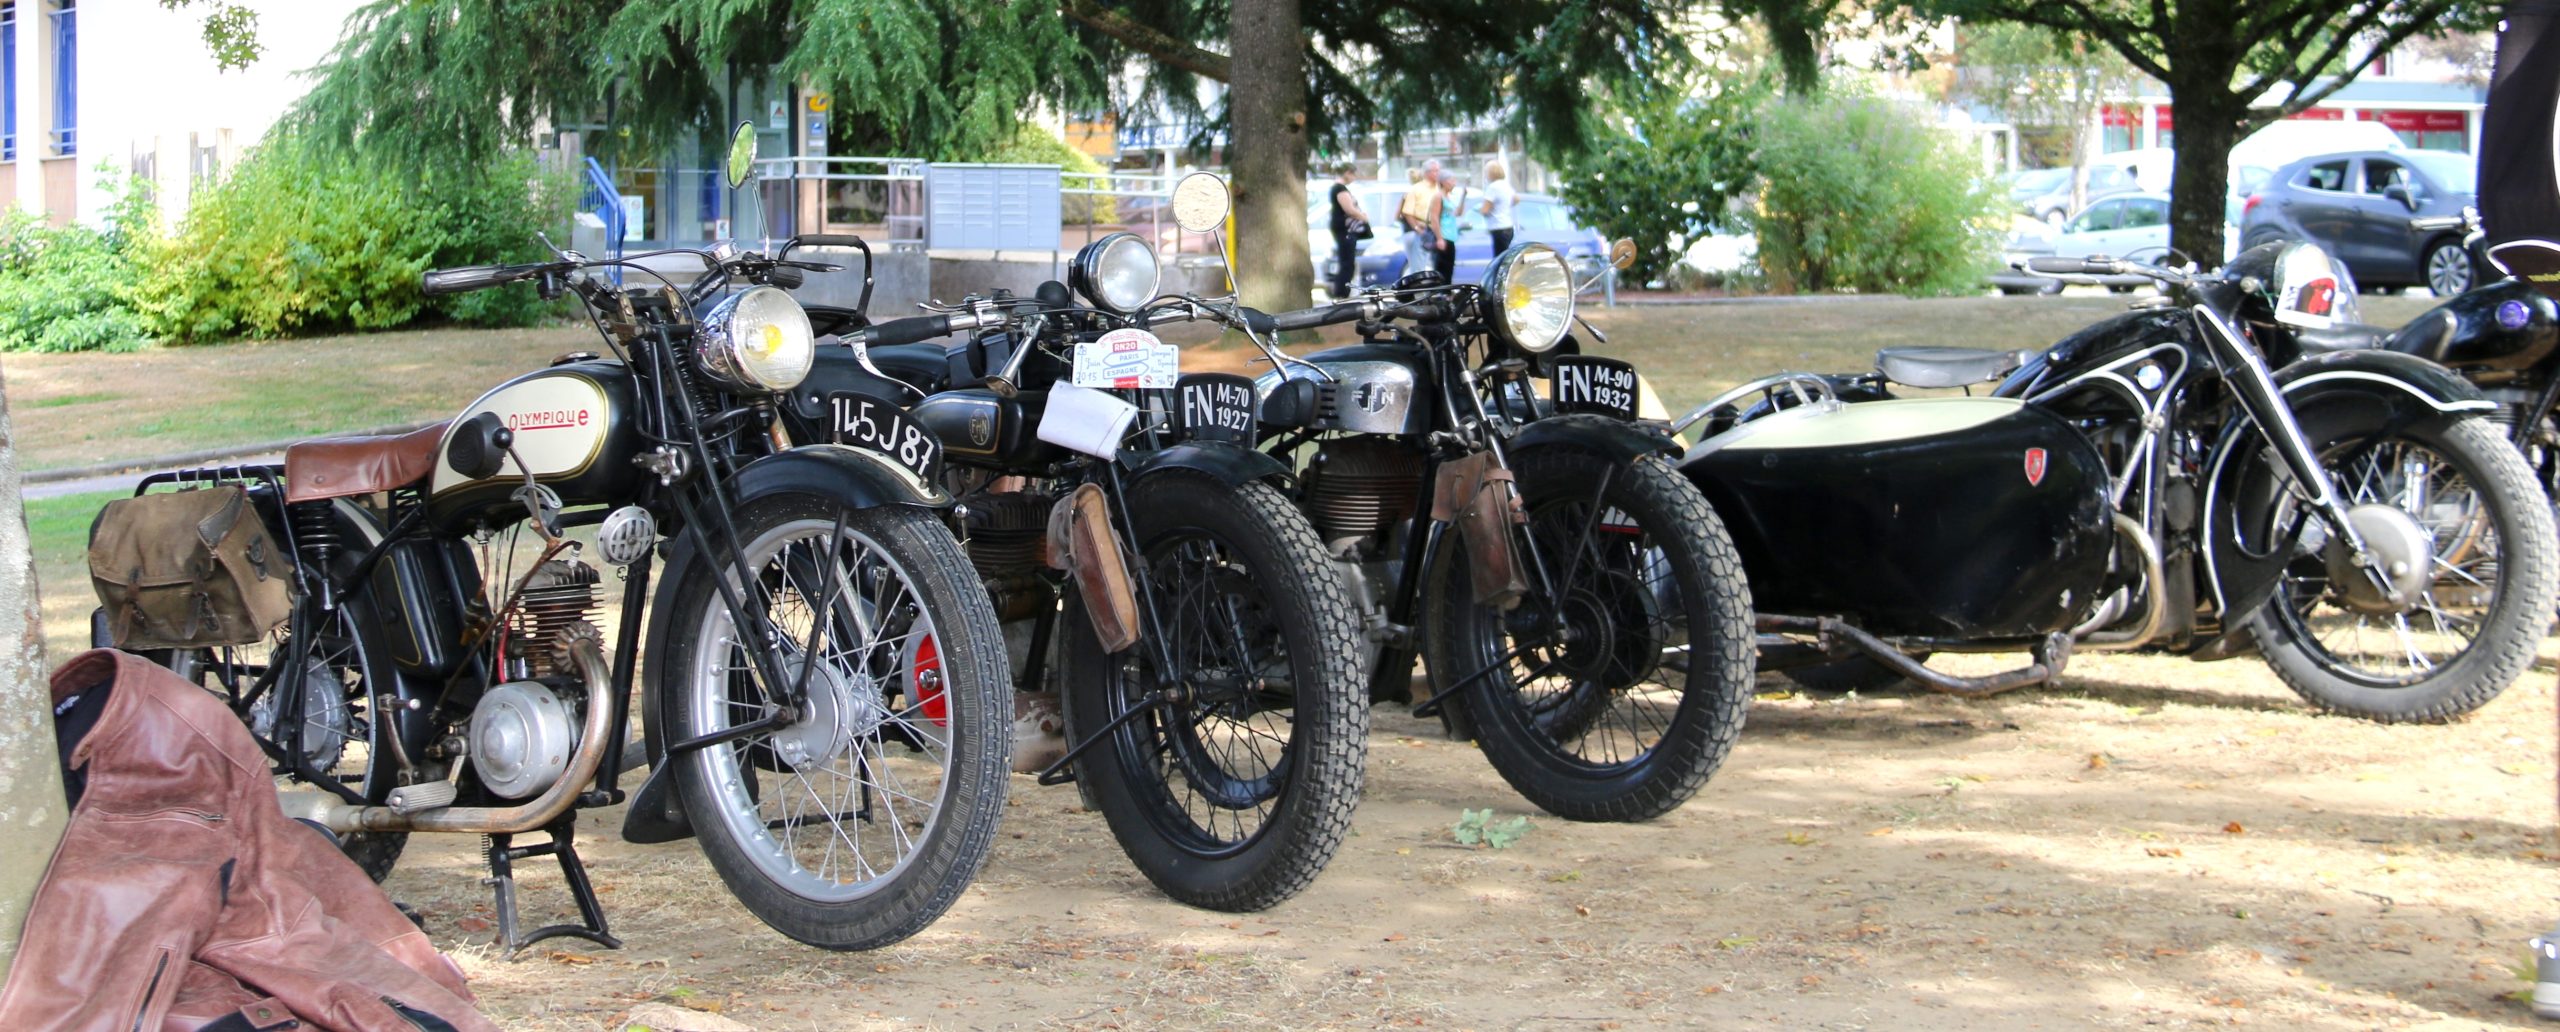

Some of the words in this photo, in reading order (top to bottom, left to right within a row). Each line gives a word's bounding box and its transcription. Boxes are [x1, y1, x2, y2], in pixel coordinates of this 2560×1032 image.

[1114, 342, 1136, 352] RN20
[1119, 353, 1139, 361] PARIS
[1106, 366, 1138, 377] ESPAGNE
[1558, 365, 1591, 403] FN
[1594, 365, 1633, 390] M-90
[1183, 383, 1214, 428] FN
[1216, 382, 1250, 408] M-70
[1594, 386, 1632, 411] 1932
[1216, 406, 1250, 431] 1927
